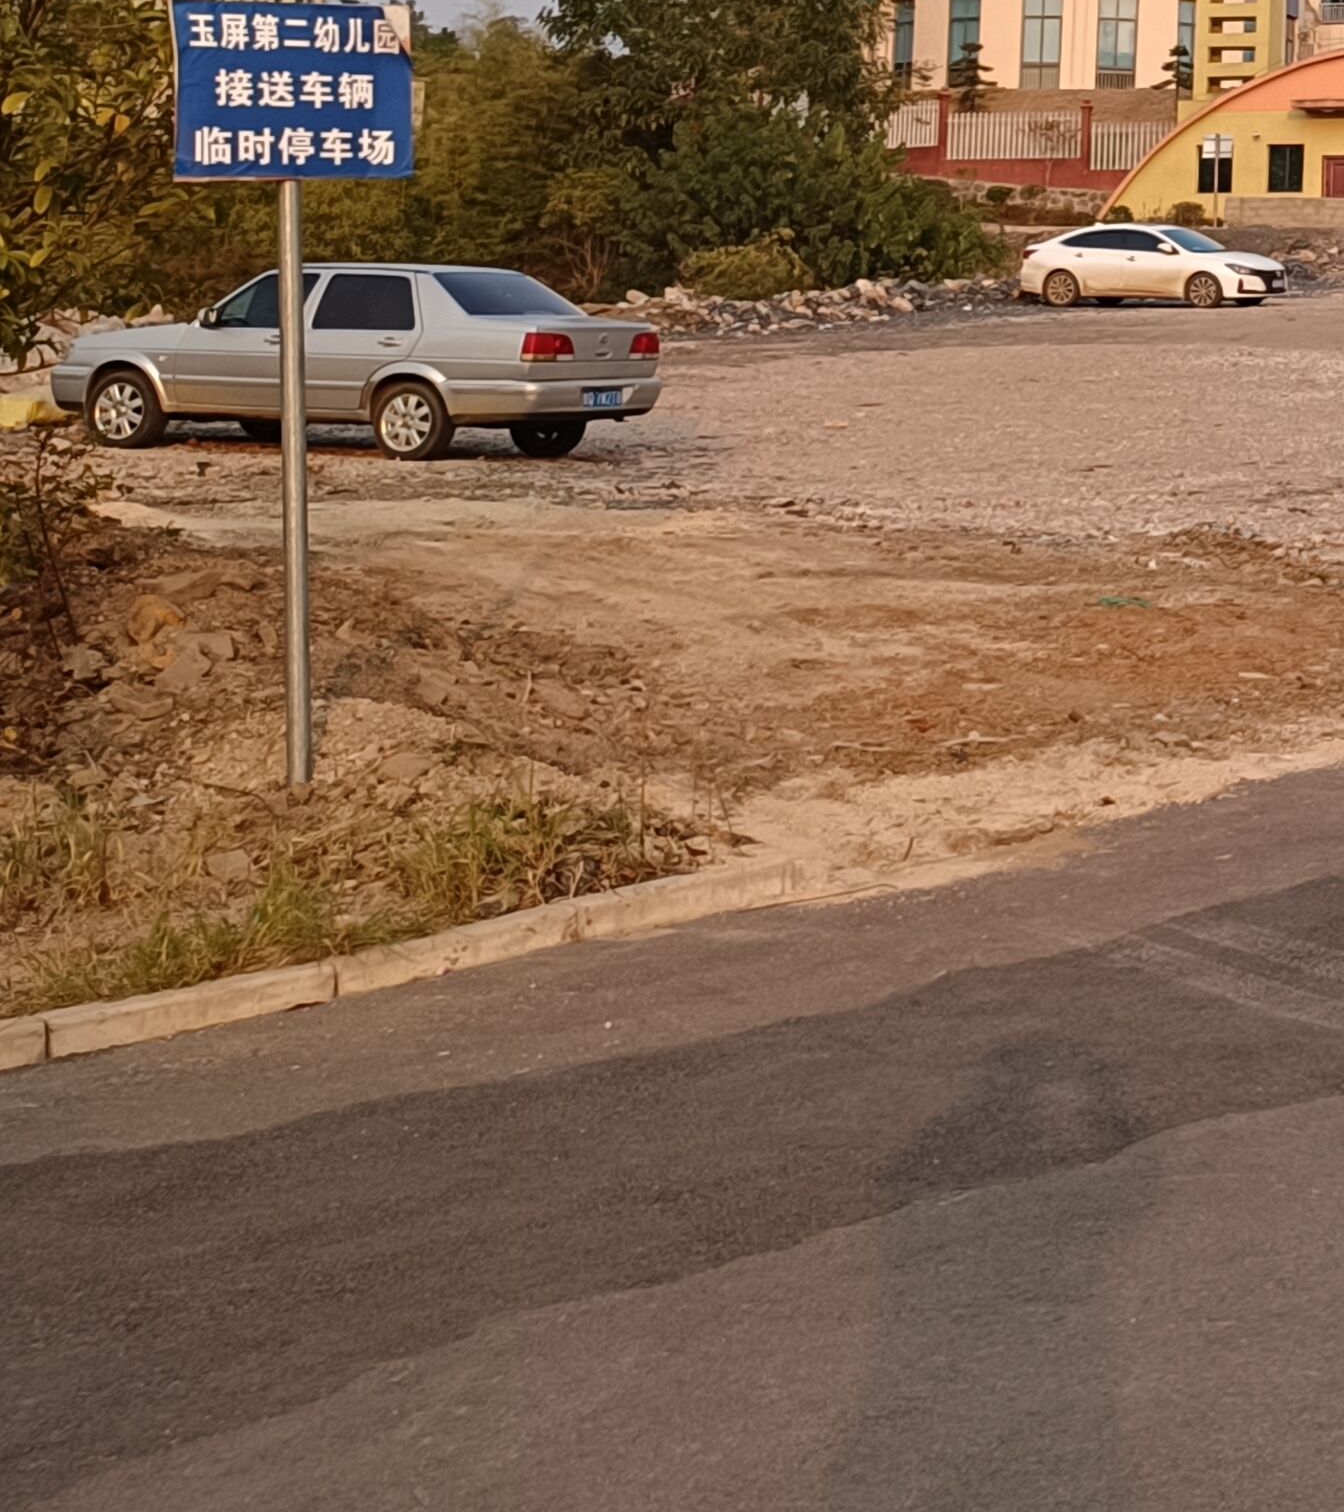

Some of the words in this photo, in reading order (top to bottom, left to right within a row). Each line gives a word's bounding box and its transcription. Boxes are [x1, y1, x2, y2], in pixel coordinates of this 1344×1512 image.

[187, 13, 400, 55] 玉屏第二幼儿园
[214, 68, 375, 109] 接送车辆
[194, 126, 396, 166] 临时停车场
